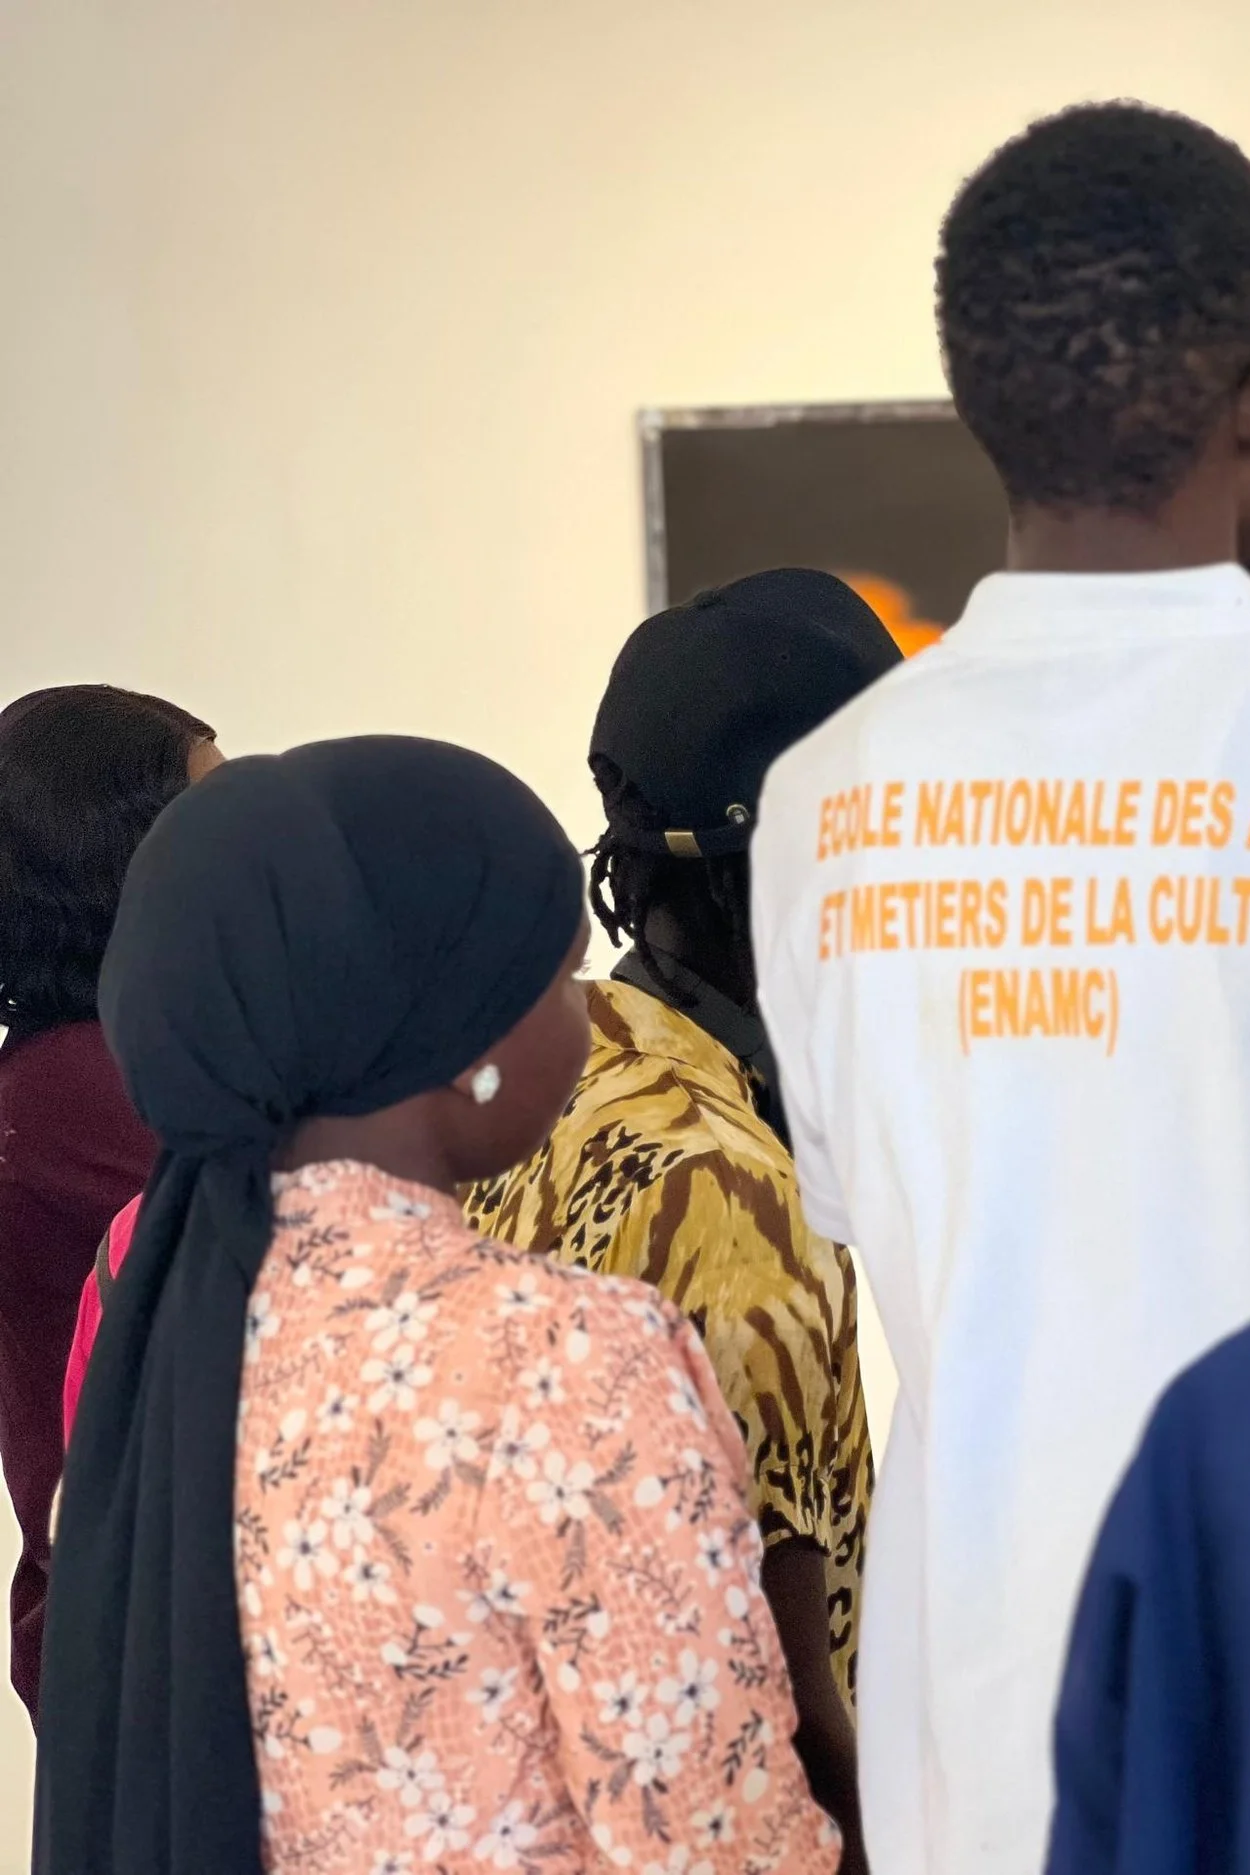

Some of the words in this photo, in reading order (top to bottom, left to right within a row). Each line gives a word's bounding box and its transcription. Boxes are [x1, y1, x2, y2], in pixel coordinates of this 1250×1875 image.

[817, 782, 904, 861] ECOLE
[915, 779, 1141, 846] NATIONALE
[1152, 780, 1235, 848] DES
[819, 891, 847, 959] ET
[851, 879, 1007, 950] METIERS
[1022, 878, 1072, 946] DE
[1086, 878, 1135, 944] LA
[959, 969, 1118, 1055] (ENAMC)
